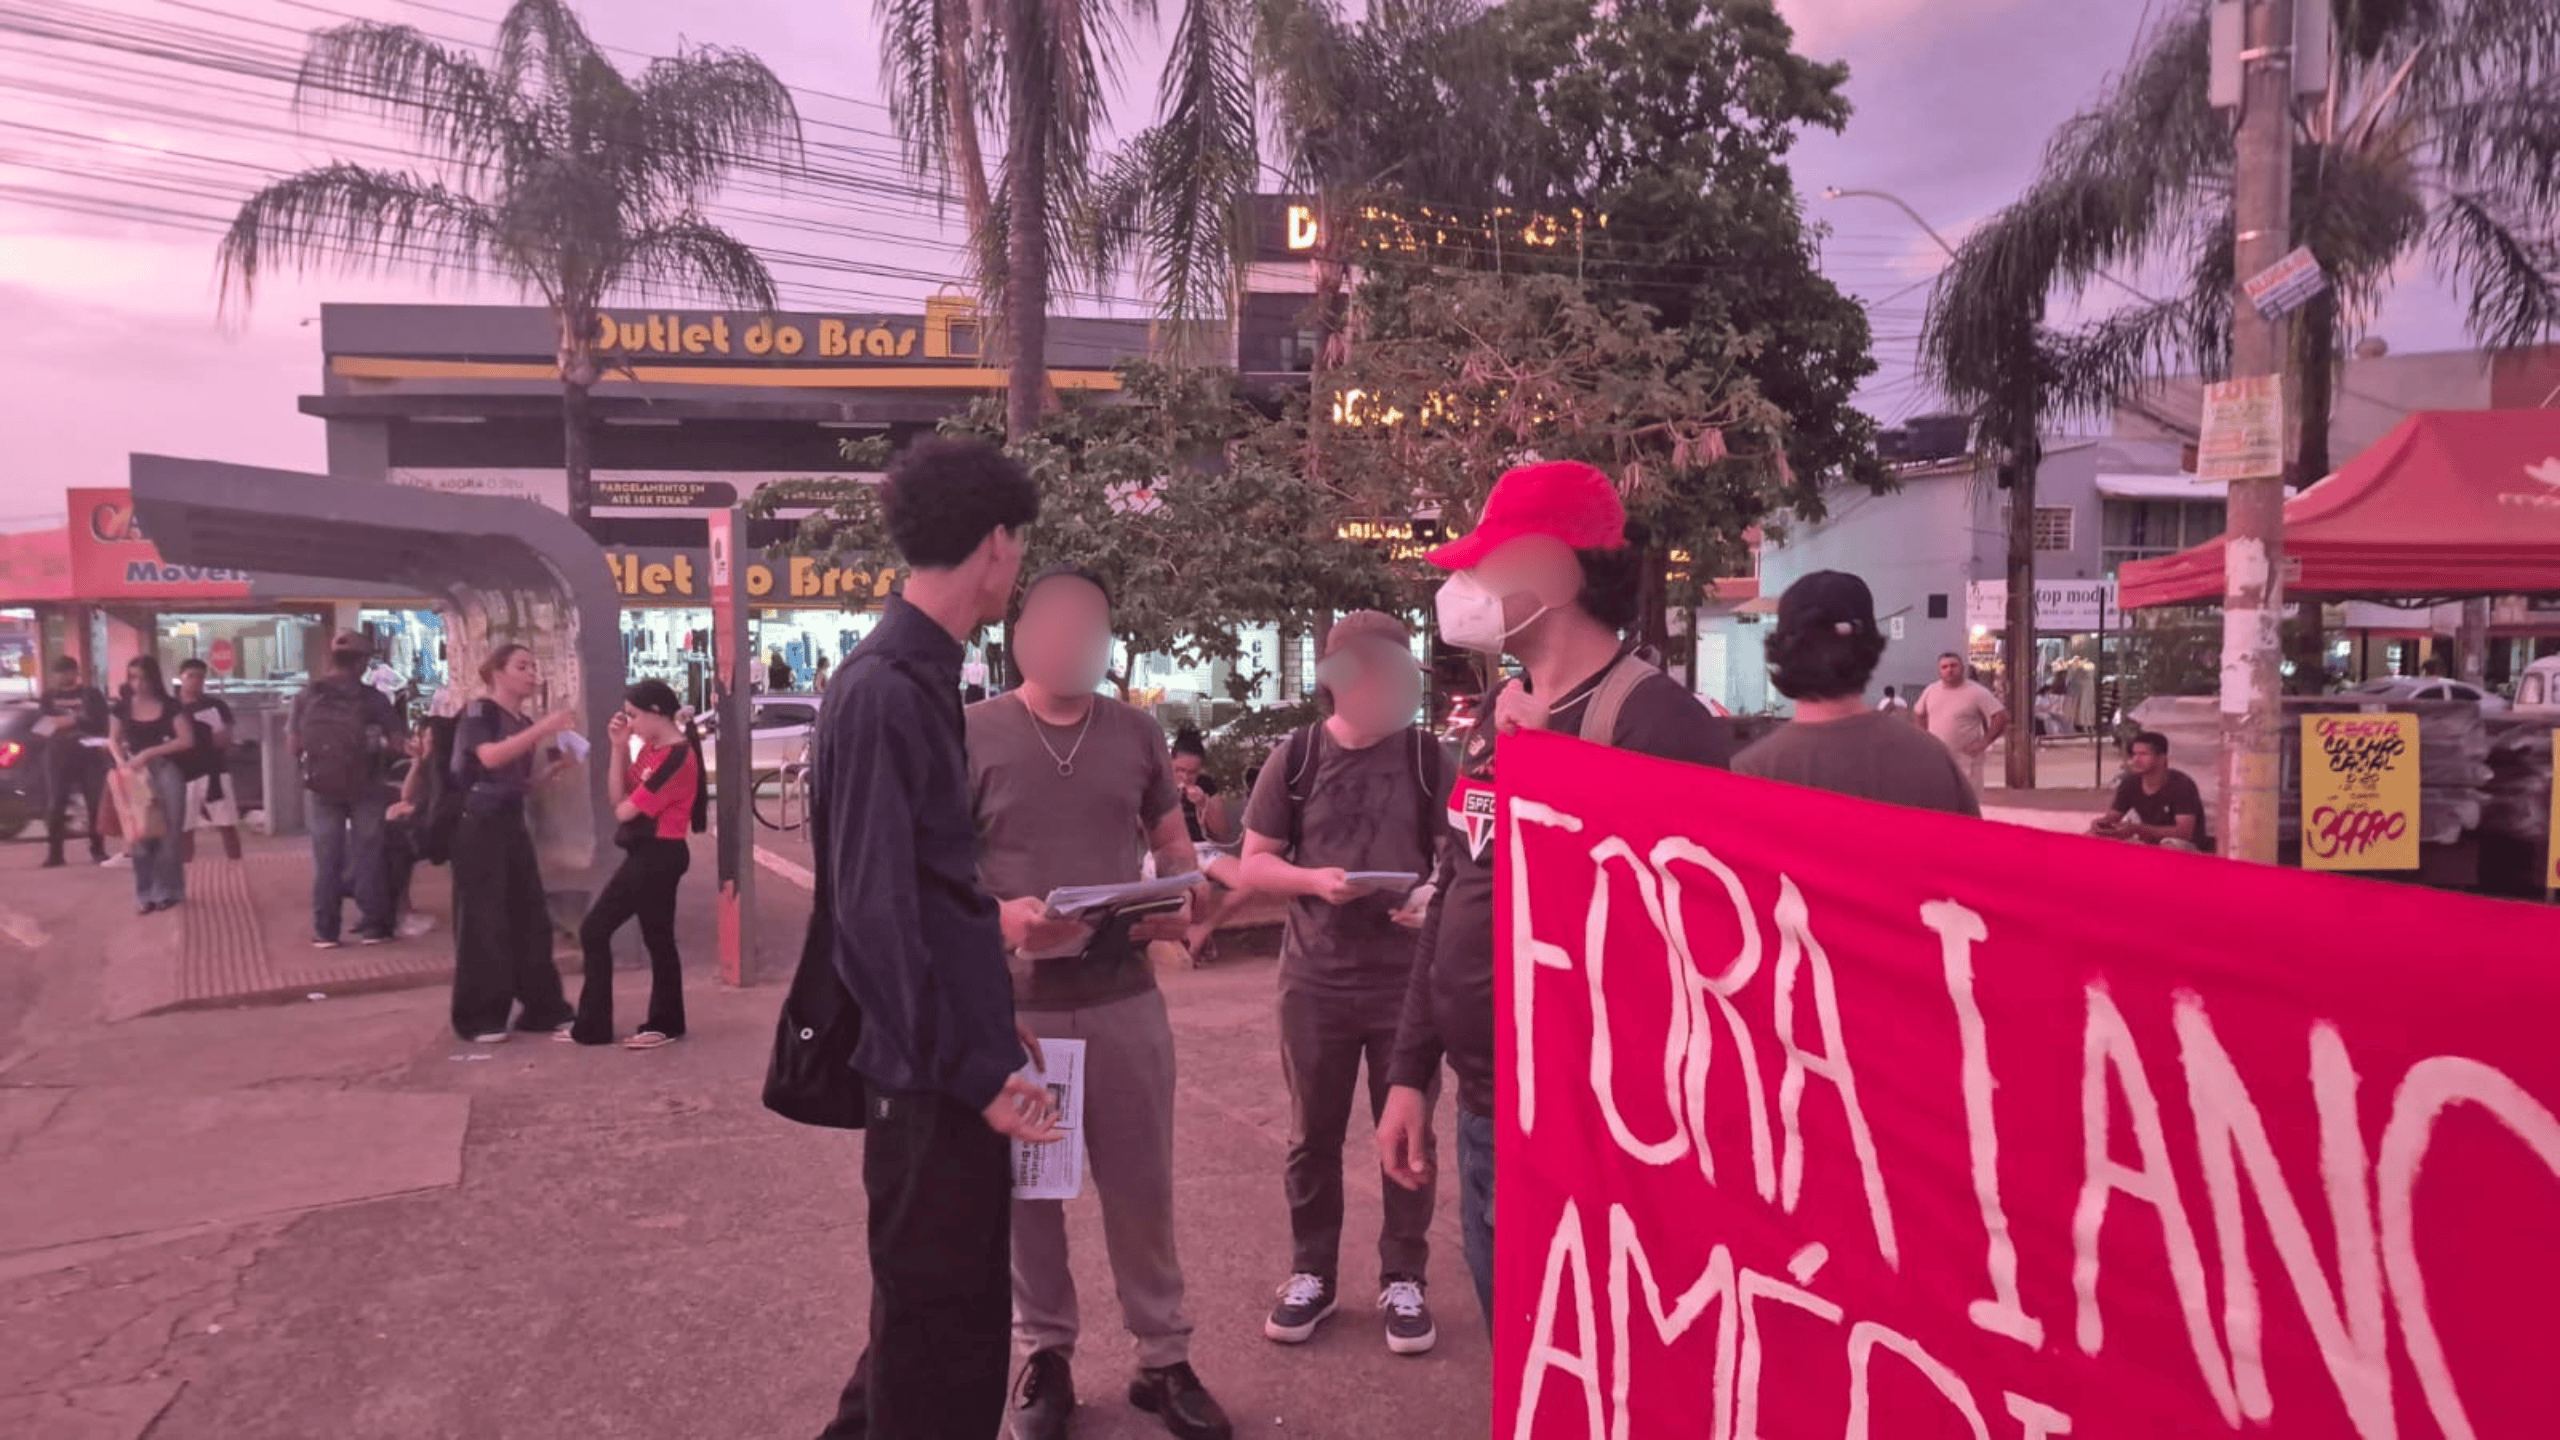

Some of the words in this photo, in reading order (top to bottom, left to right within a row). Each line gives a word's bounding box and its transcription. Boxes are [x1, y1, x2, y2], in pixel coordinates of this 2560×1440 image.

[744, 316, 804, 355] do
[818, 318, 917, 358] Brás
[2066, 584, 2115, 603] modl
[1508, 796, 1899, 1274] FORA
